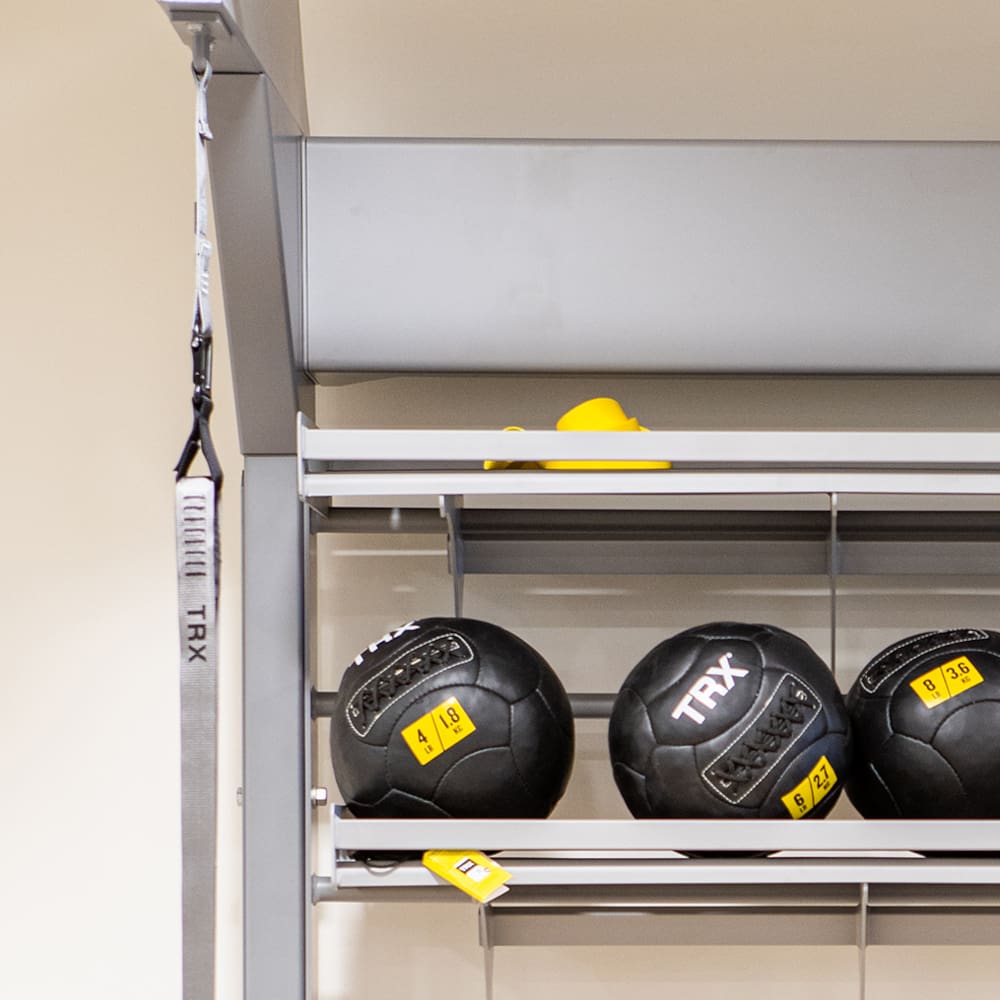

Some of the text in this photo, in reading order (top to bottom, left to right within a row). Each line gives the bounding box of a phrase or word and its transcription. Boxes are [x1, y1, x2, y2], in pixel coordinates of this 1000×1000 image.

[187, 605, 207, 662] TRX
[671, 653, 750, 725] TRX
[922, 662, 970, 692] 8 3.6
[417, 728, 428, 743] 4
[793, 793, 805, 807] 6
